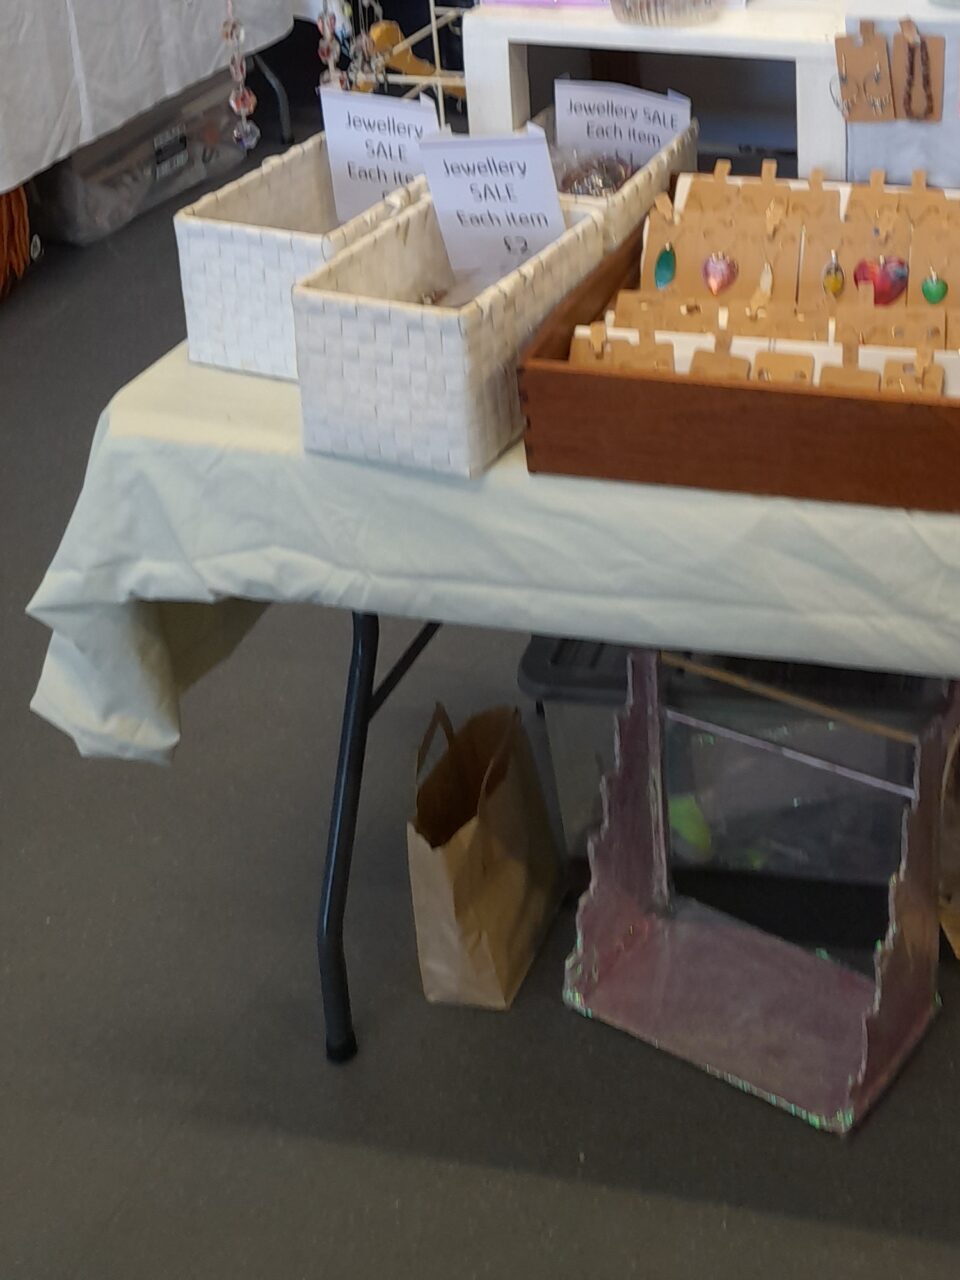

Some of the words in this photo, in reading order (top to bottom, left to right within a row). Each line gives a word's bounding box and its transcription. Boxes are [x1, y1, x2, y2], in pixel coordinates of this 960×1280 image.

[346, 110, 424, 141] Jewellery
[568, 99, 639, 122] Jewellery
[643, 106, 680, 130] SALE
[586, 121, 623, 139] Each
[628, 127, 661, 147] item
[364, 139, 408, 162] SALE
[346, 161, 388, 183] Each
[393, 170, 415, 185] ite
[441, 156, 528, 179] Jewellery
[469, 182, 517, 202] SALE
[456, 209, 502, 227] Each
[505, 210, 550, 228] item
